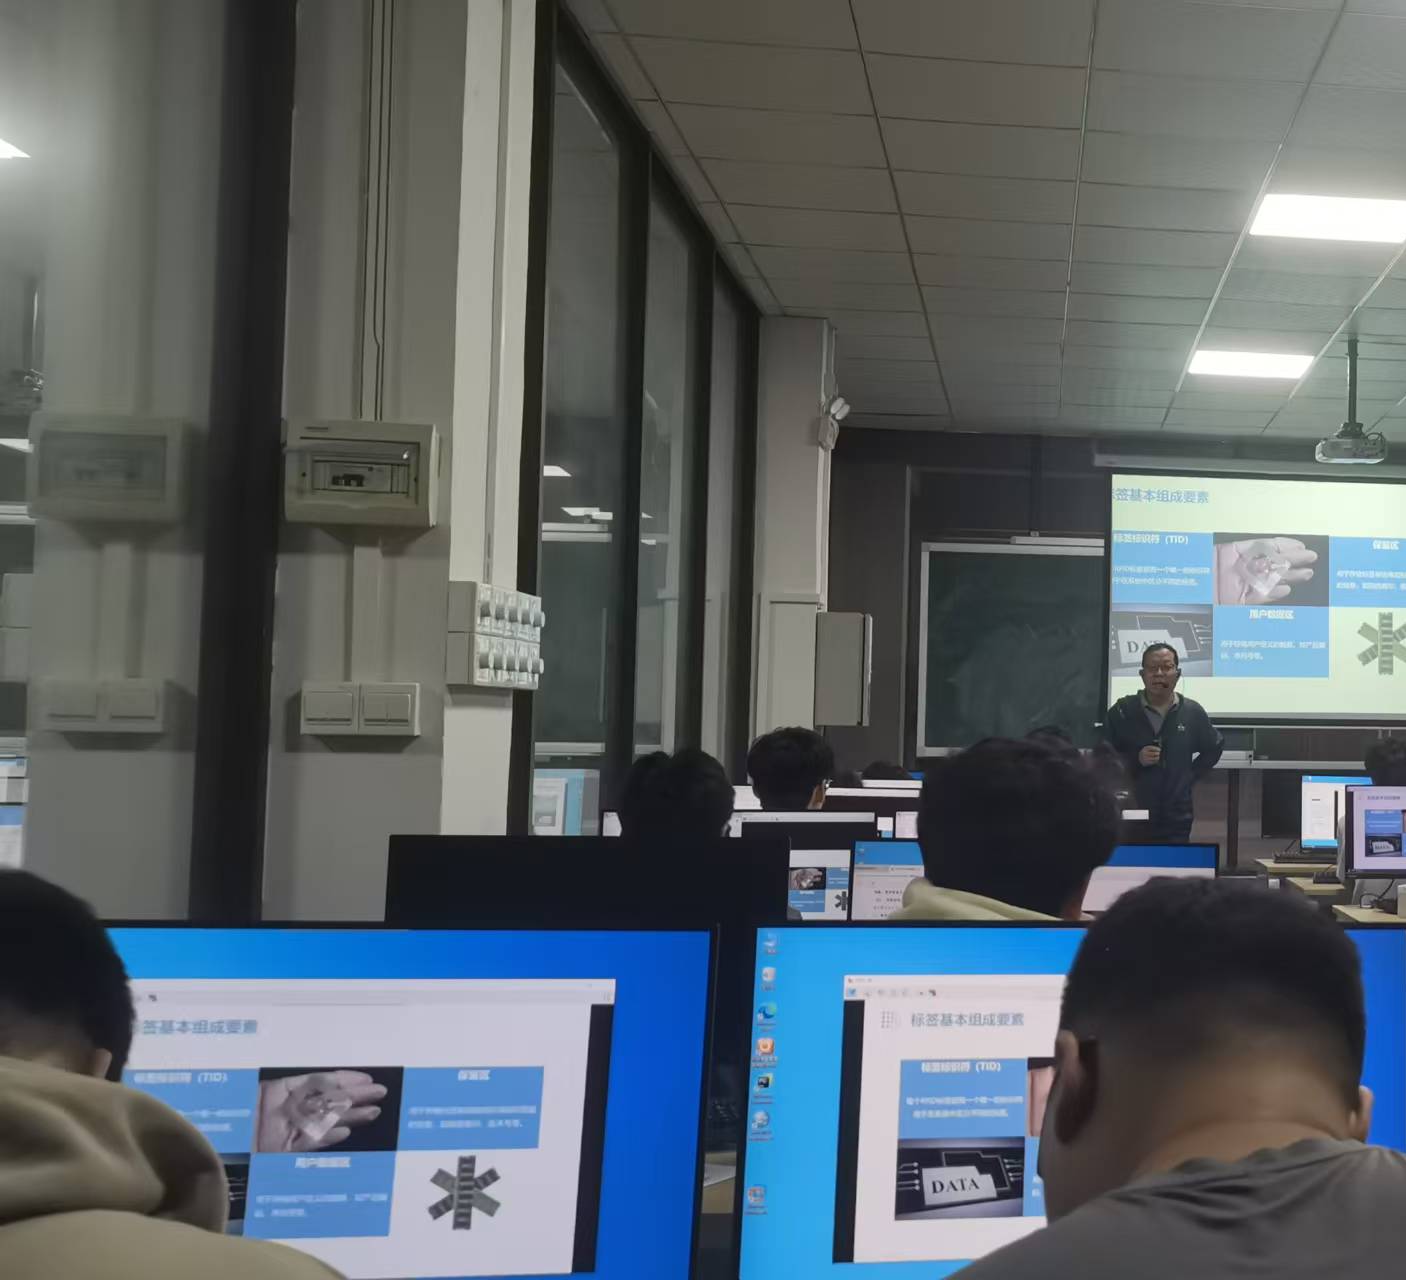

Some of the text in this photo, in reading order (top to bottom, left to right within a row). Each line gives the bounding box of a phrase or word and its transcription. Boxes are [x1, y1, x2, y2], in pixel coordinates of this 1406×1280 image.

[1112, 487, 1209, 504] 签基本组成要素
[910, 1012, 1025, 1028] 标签基本组成要素
[931, 1177, 980, 1194] DATA
